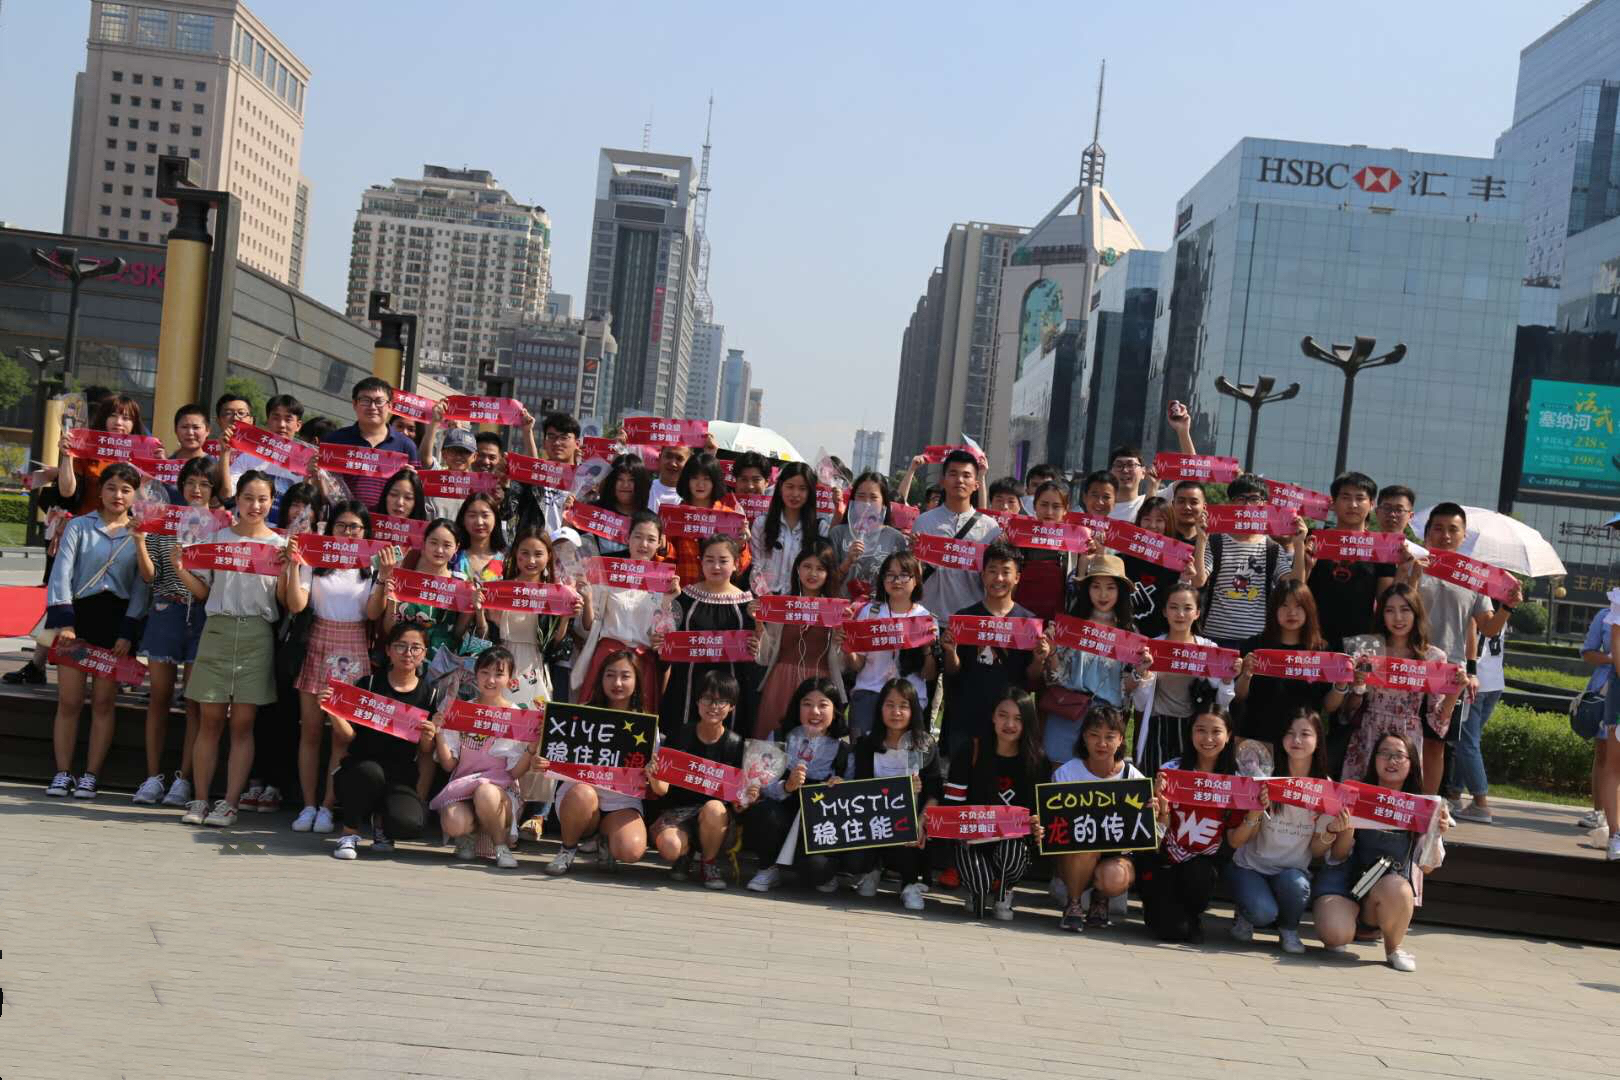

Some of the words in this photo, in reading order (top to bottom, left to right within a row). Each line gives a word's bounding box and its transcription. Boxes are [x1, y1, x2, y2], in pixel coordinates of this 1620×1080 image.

[1257, 156, 1350, 190] HSBC
[1408, 170, 1506, 201] 汇丰
[398, 394, 426, 407] 不负众望
[470, 400, 500, 410] 不负众望
[395, 404, 423, 418] 逐梦曲江
[469, 410, 500, 420] 逐梦曲江
[650, 422, 681, 432] 不负众望
[1539, 411, 1592, 431] 塞纳河
[98, 436, 132, 448] 不负众望
[260, 434, 292, 453] 不负众望
[649, 432, 680, 442] 逐梦曲江
[97, 446, 130, 458] 逐梦曲江
[256, 445, 288, 464] 逐梦曲江
[346, 449, 379, 461] 不负众望
[346, 459, 379, 471] 逐梦曲江
[532, 461, 564, 475] 不负众望
[1180, 458, 1210, 468] 不负众望
[440, 474, 471, 485] 不负众望
[531, 471, 562, 483] 逐梦曲江
[1179, 468, 1210, 478] 逐梦曲江
[439, 484, 470, 495] 逐梦曲江
[1273, 486, 1304, 499] 不负众望
[1272, 496, 1301, 508] 逐梦曲江
[591, 510, 623, 526] 不负众望
[684, 512, 716, 523] 不负众望
[1234, 509, 1267, 521] 不负众望
[376, 520, 410, 532] 不负众望
[588, 520, 619, 536] 逐梦曲江
[684, 523, 715, 534] 逐梦曲江
[1032, 525, 1063, 536] 不负众望
[1234, 521, 1266, 531] 逐梦曲江
[375, 530, 408, 543] 逐梦曲江
[1031, 536, 1063, 547] 逐梦曲江
[1132, 533, 1164, 548] 不负众望
[1340, 535, 1373, 545] 不负众望
[215, 544, 251, 556] 不负众望
[322, 540, 358, 553] 不负众望
[944, 542, 977, 554] 不负众望
[1129, 543, 1160, 560] 逐梦曲江
[1339, 546, 1372, 557] 逐梦曲江
[215, 555, 251, 567] 逐梦曲江
[322, 551, 358, 564] 逐梦曲江
[942, 553, 974, 567] 逐梦曲江
[611, 561, 643, 573] 不负众望
[1457, 559, 1489, 576] 不负众望
[421, 578, 456, 592] 不负众望
[610, 572, 642, 585] 逐梦曲江
[1451, 570, 1484, 588] 逐梦曲江
[419, 590, 454, 603] 逐梦曲江
[513, 586, 547, 597] 不负众望
[512, 597, 545, 609] 逐梦曲江
[785, 600, 819, 611] 不负众望
[785, 612, 818, 623] 逐梦曲江
[870, 620, 904, 634] 不负众望
[978, 619, 1012, 630] 不负众望
[871, 632, 904, 646] 逐梦曲江
[977, 630, 1012, 643] 逐梦曲江
[1081, 625, 1116, 642] 不负众望
[689, 636, 722, 646] 不负众望
[1079, 636, 1113, 653] 逐梦曲江
[689, 646, 721, 657] 逐梦曲江
[1172, 647, 1207, 660] 不负众望
[1171, 659, 1205, 672] 逐梦曲江
[1285, 654, 1320, 664] 不负众望
[1285, 665, 1320, 676] 逐梦曲江
[1391, 662, 1426, 673] 不负众望
[1389, 673, 1424, 686] 逐梦曲江
[359, 694, 395, 714] 不负众望
[353, 708, 391, 727] 逐梦曲江
[474, 708, 510, 721] 不负众望
[473, 719, 508, 733] 逐梦曲江
[578, 769, 613, 780] 不负众望
[688, 761, 724, 778] 不负众望
[684, 774, 720, 790] 逐梦曲江
[1194, 777, 1231, 790] 不负众望
[1285, 779, 1323, 793] 不负众望
[1046, 791, 1116, 811] CONDI
[1193, 790, 1230, 803] 逐梦曲江
[1283, 789, 1320, 807] 逐梦曲江
[1377, 793, 1414, 810] 不负众望
[959, 810, 996, 820] 不负众望
[1374, 806, 1411, 823] 逐梦曲江
[959, 822, 996, 833] 逐梦曲江
[1048, 811, 1153, 845] 龙的传人
